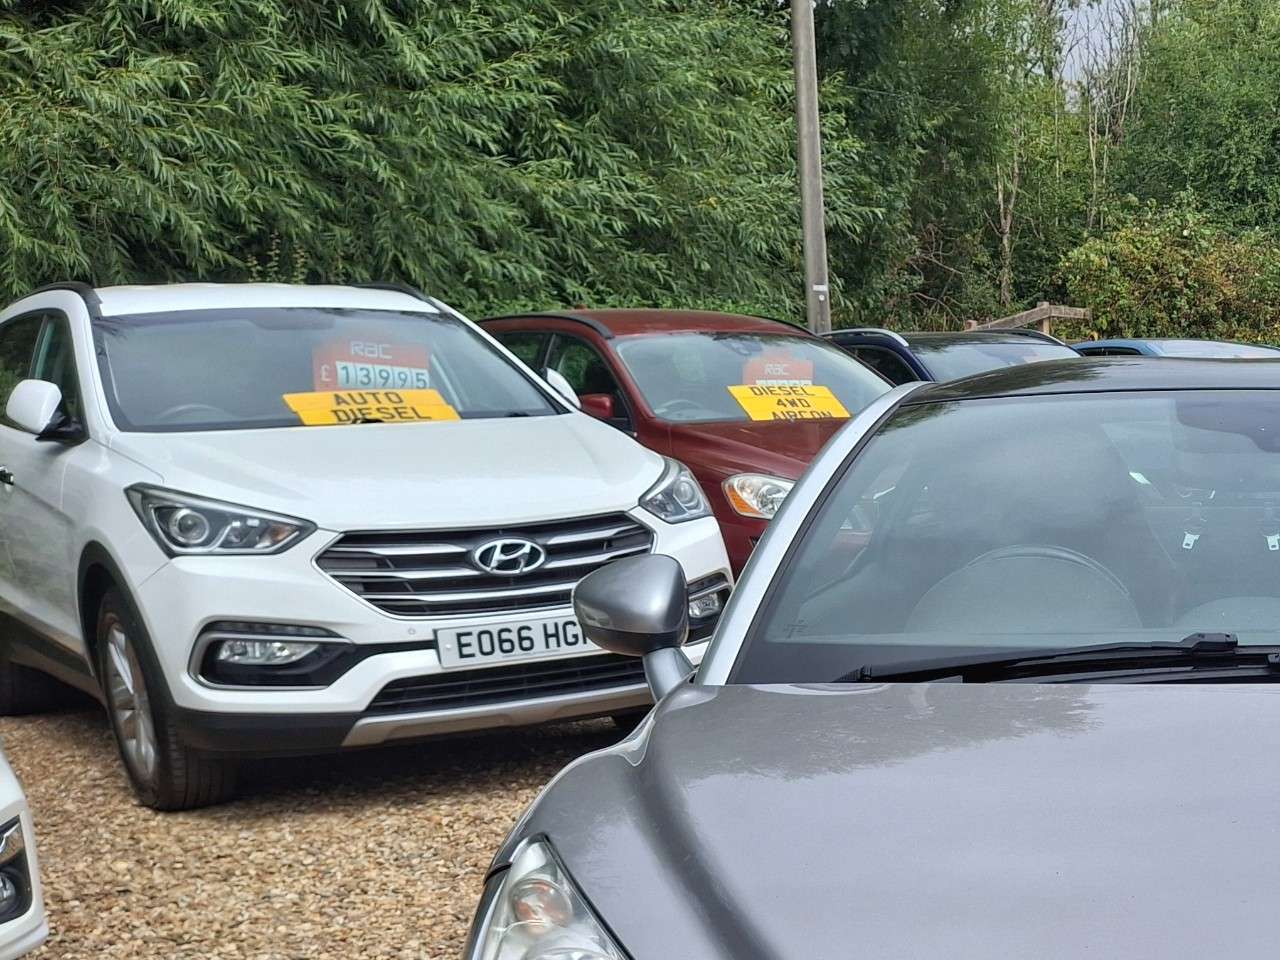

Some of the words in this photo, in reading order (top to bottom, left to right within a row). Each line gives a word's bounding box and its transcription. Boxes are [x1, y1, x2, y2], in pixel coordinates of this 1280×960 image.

[748, 385, 816, 396] DIESEL
[332, 391, 404, 406] AUTO
[776, 398, 812, 408] 4WD
[330, 406, 433, 424] DIESEL
[542, 620, 588, 649] HG
